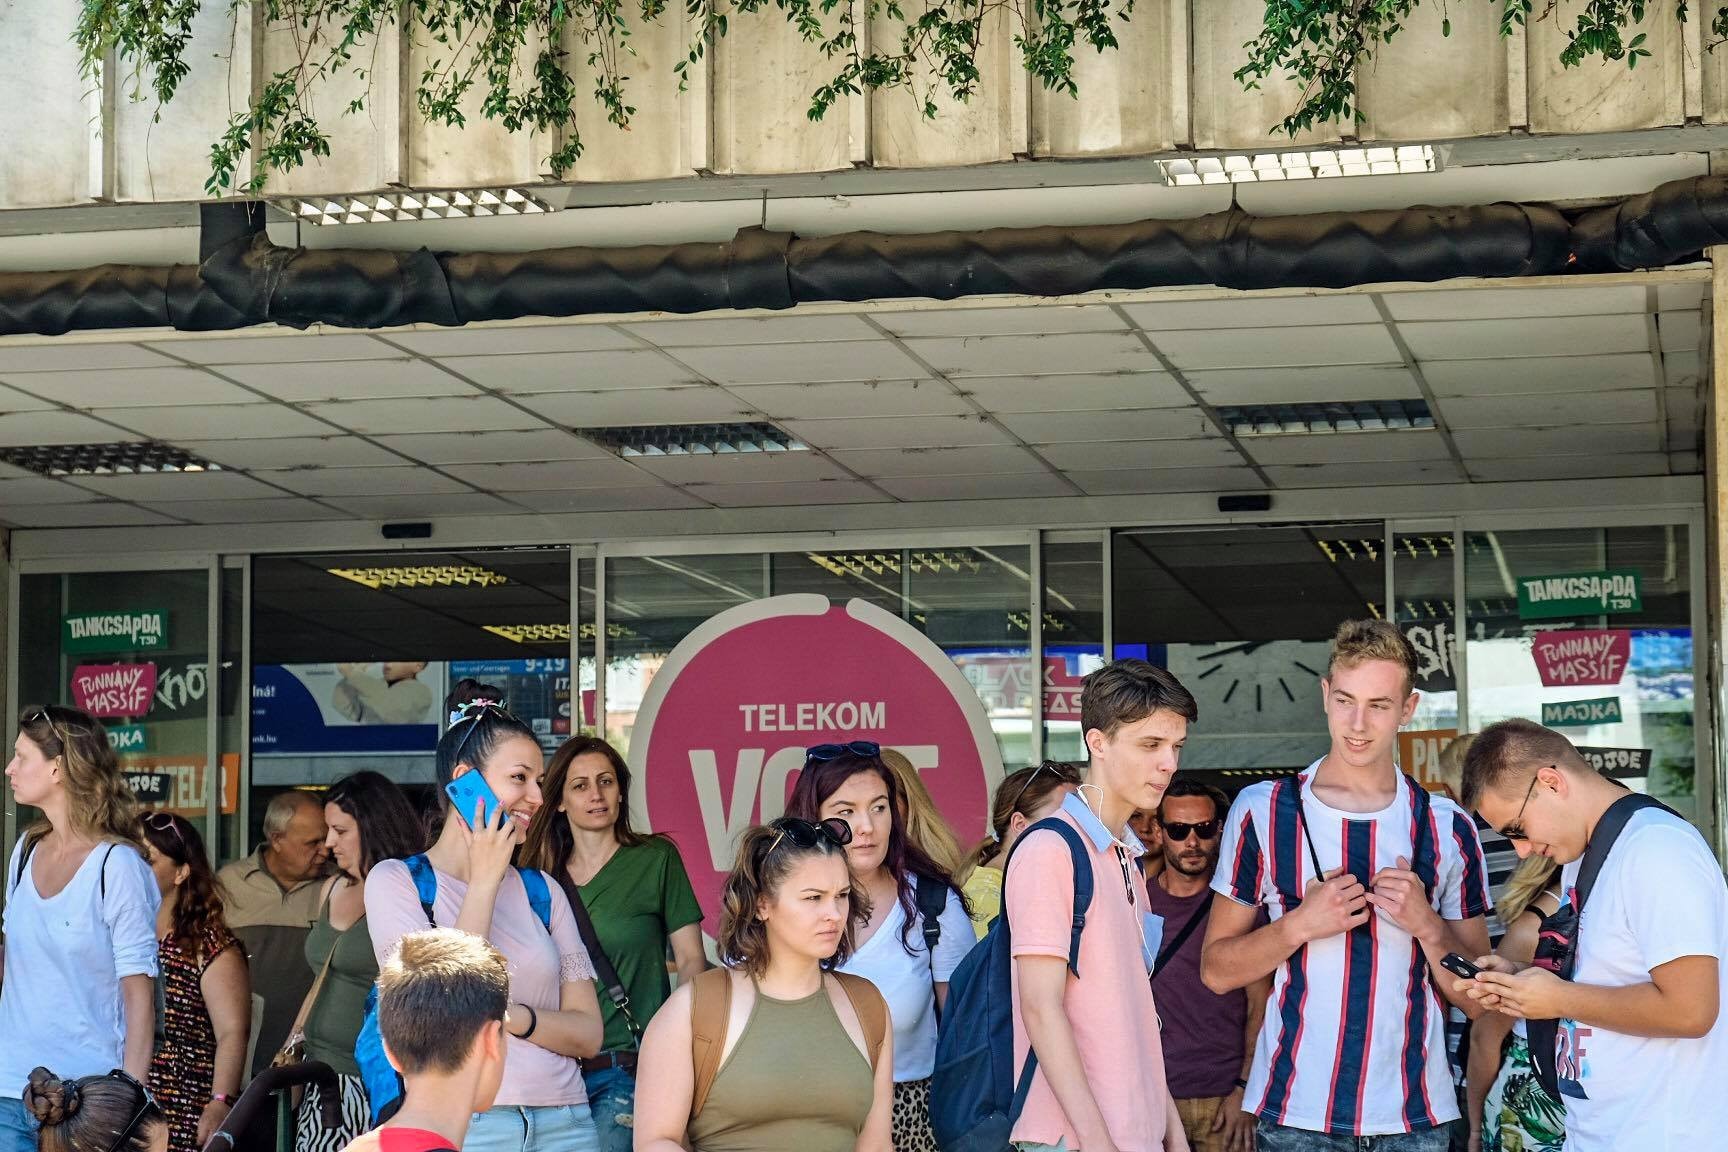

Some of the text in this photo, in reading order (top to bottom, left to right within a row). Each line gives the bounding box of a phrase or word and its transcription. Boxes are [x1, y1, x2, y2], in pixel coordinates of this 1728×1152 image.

[555, 678, 570, 690] IT
[739, 702, 886, 732] TELEKOM
[1544, 701, 1619, 722] MAJKA
